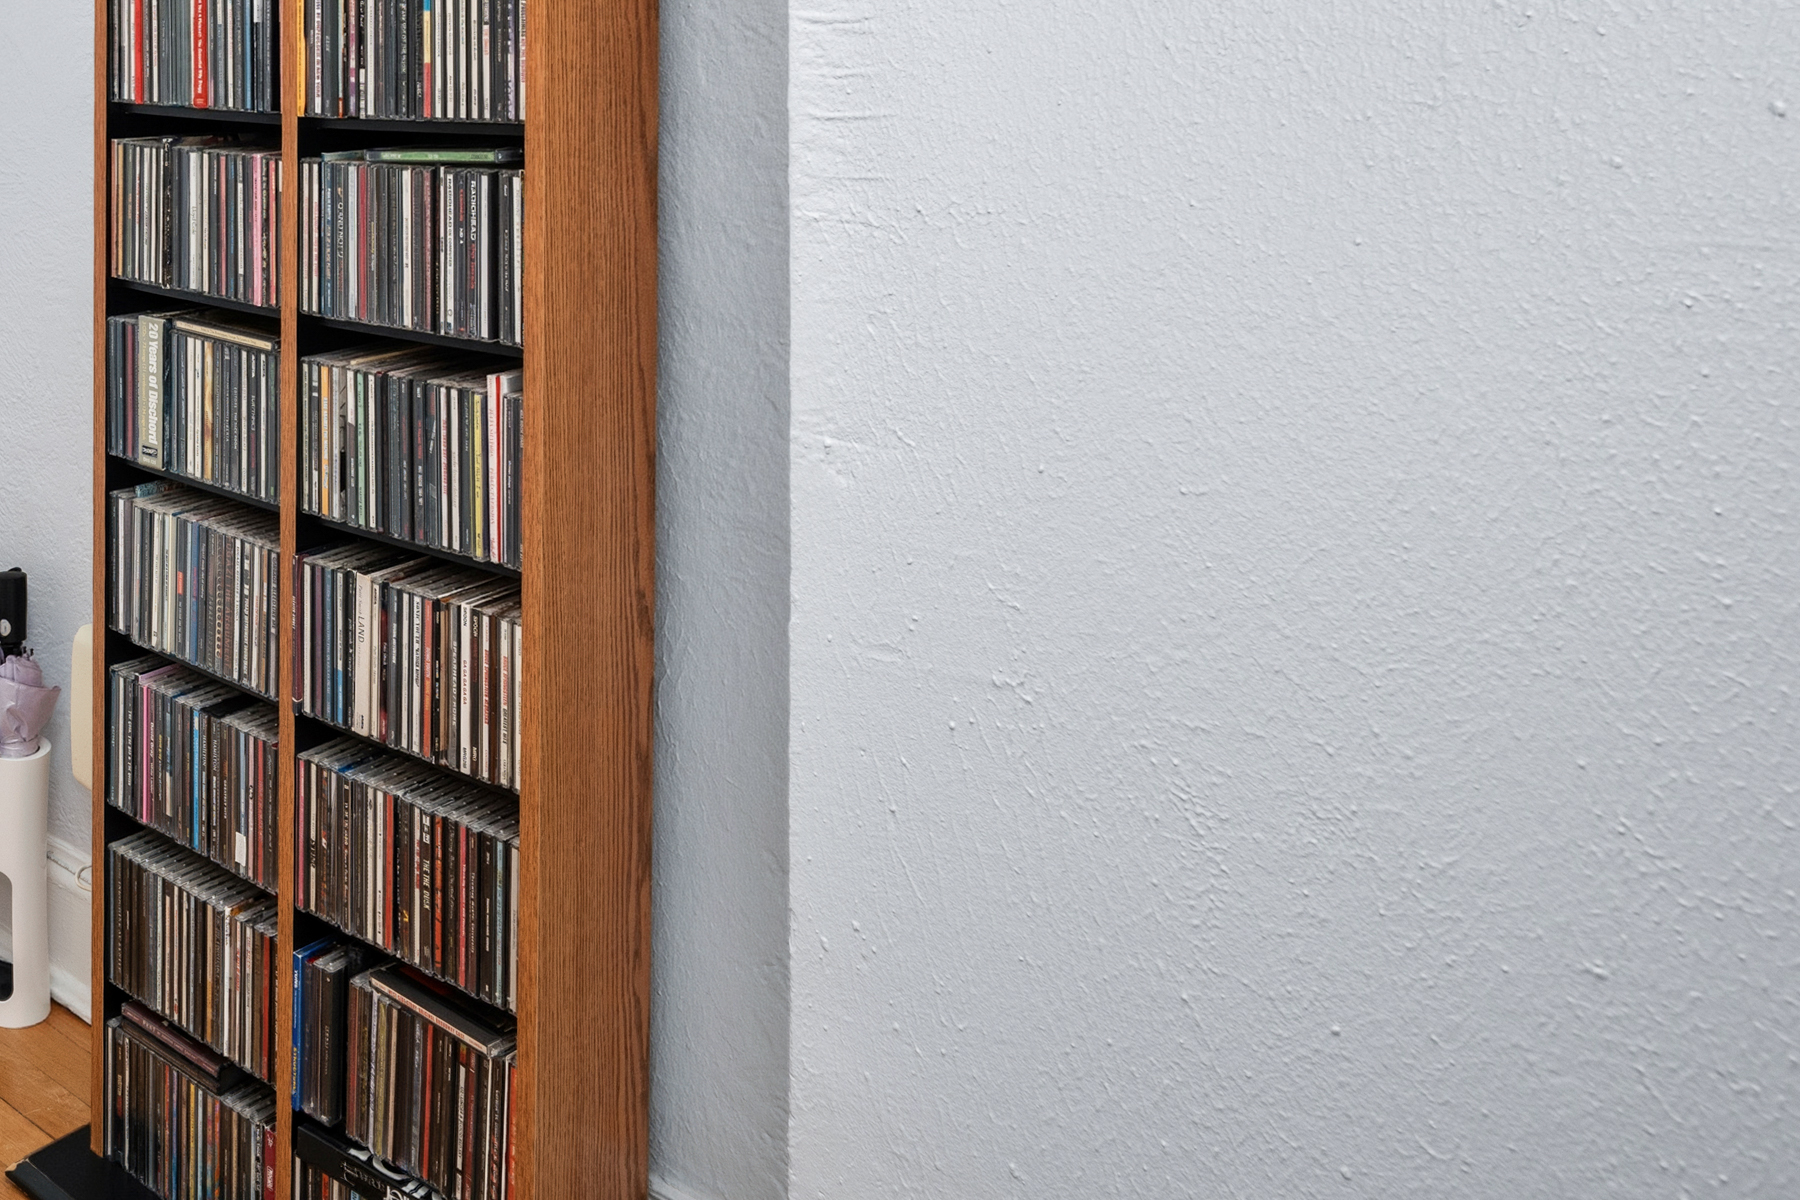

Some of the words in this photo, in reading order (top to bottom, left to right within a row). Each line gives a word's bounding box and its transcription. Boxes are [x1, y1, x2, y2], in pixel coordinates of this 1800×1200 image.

[148, 322, 158, 338] 20
[148, 339, 158, 374] Years
[148, 375, 158, 387] of
[148, 389, 158, 444] Dischord
